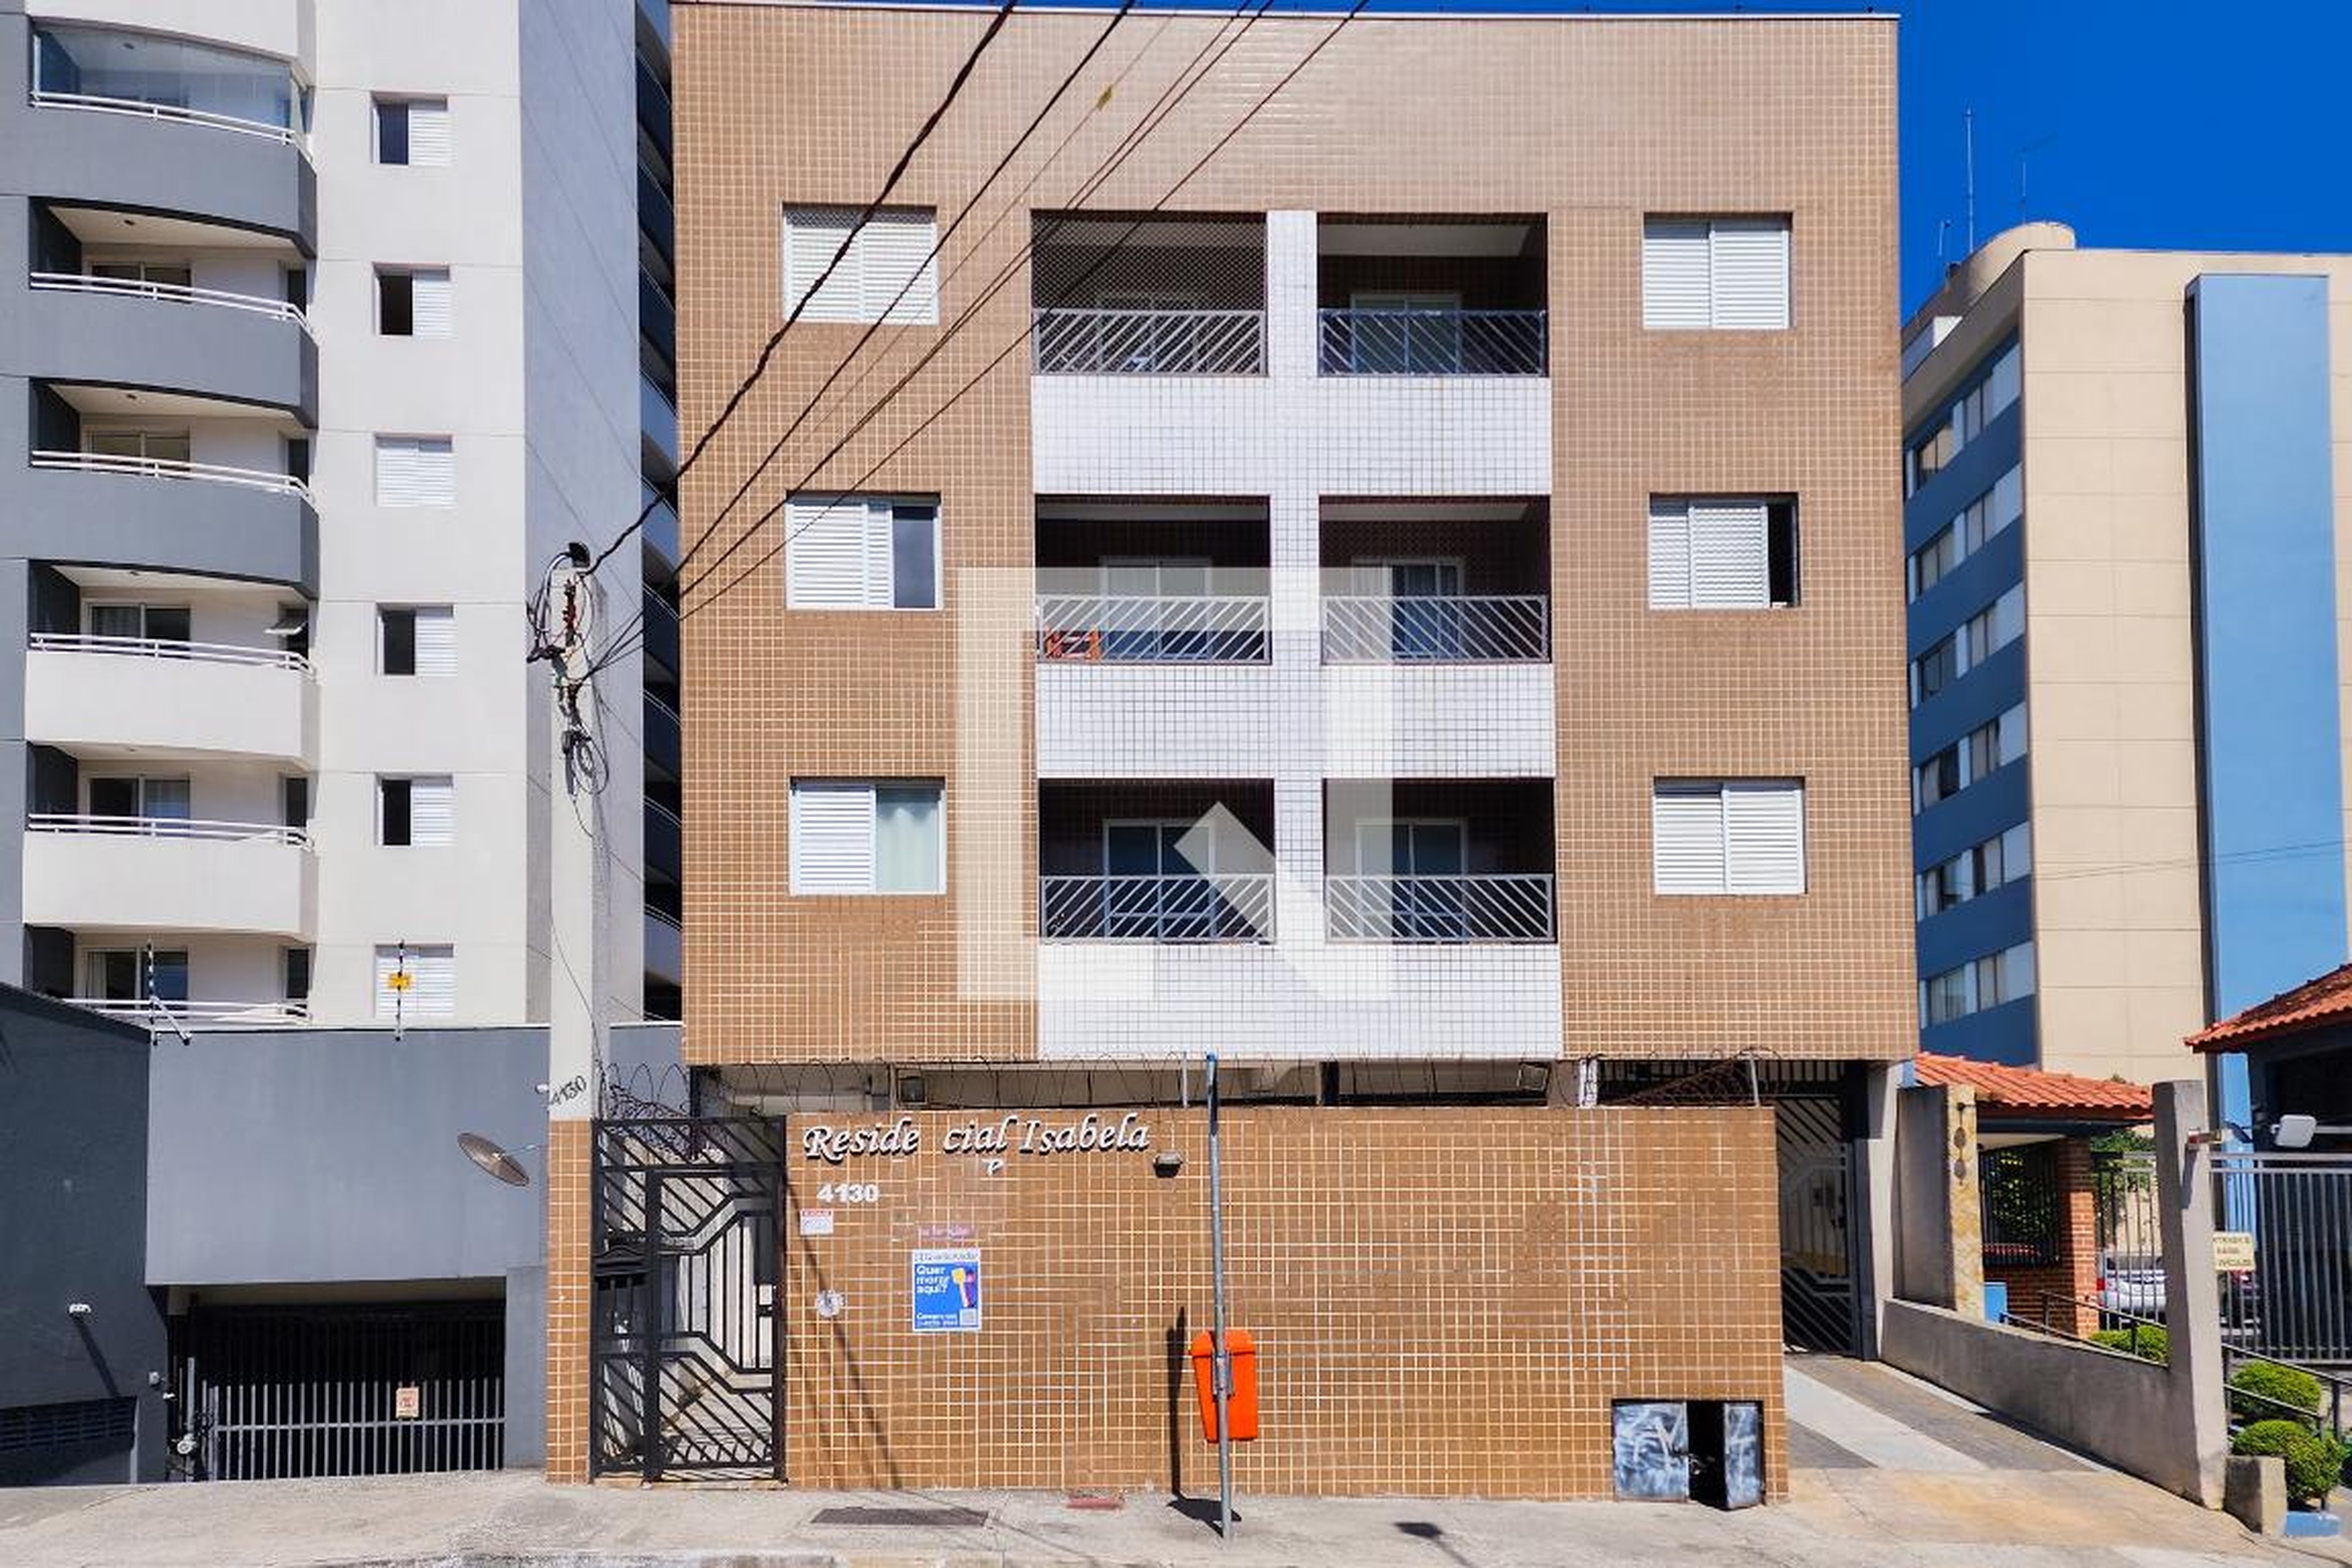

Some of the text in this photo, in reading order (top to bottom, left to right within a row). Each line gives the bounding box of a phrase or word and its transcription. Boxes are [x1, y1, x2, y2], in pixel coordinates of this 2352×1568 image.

[1019, 1112, 1150, 1155] Isabela
[816, 1183, 879, 1203] 4130
[916, 1265, 946, 1275] Quer
